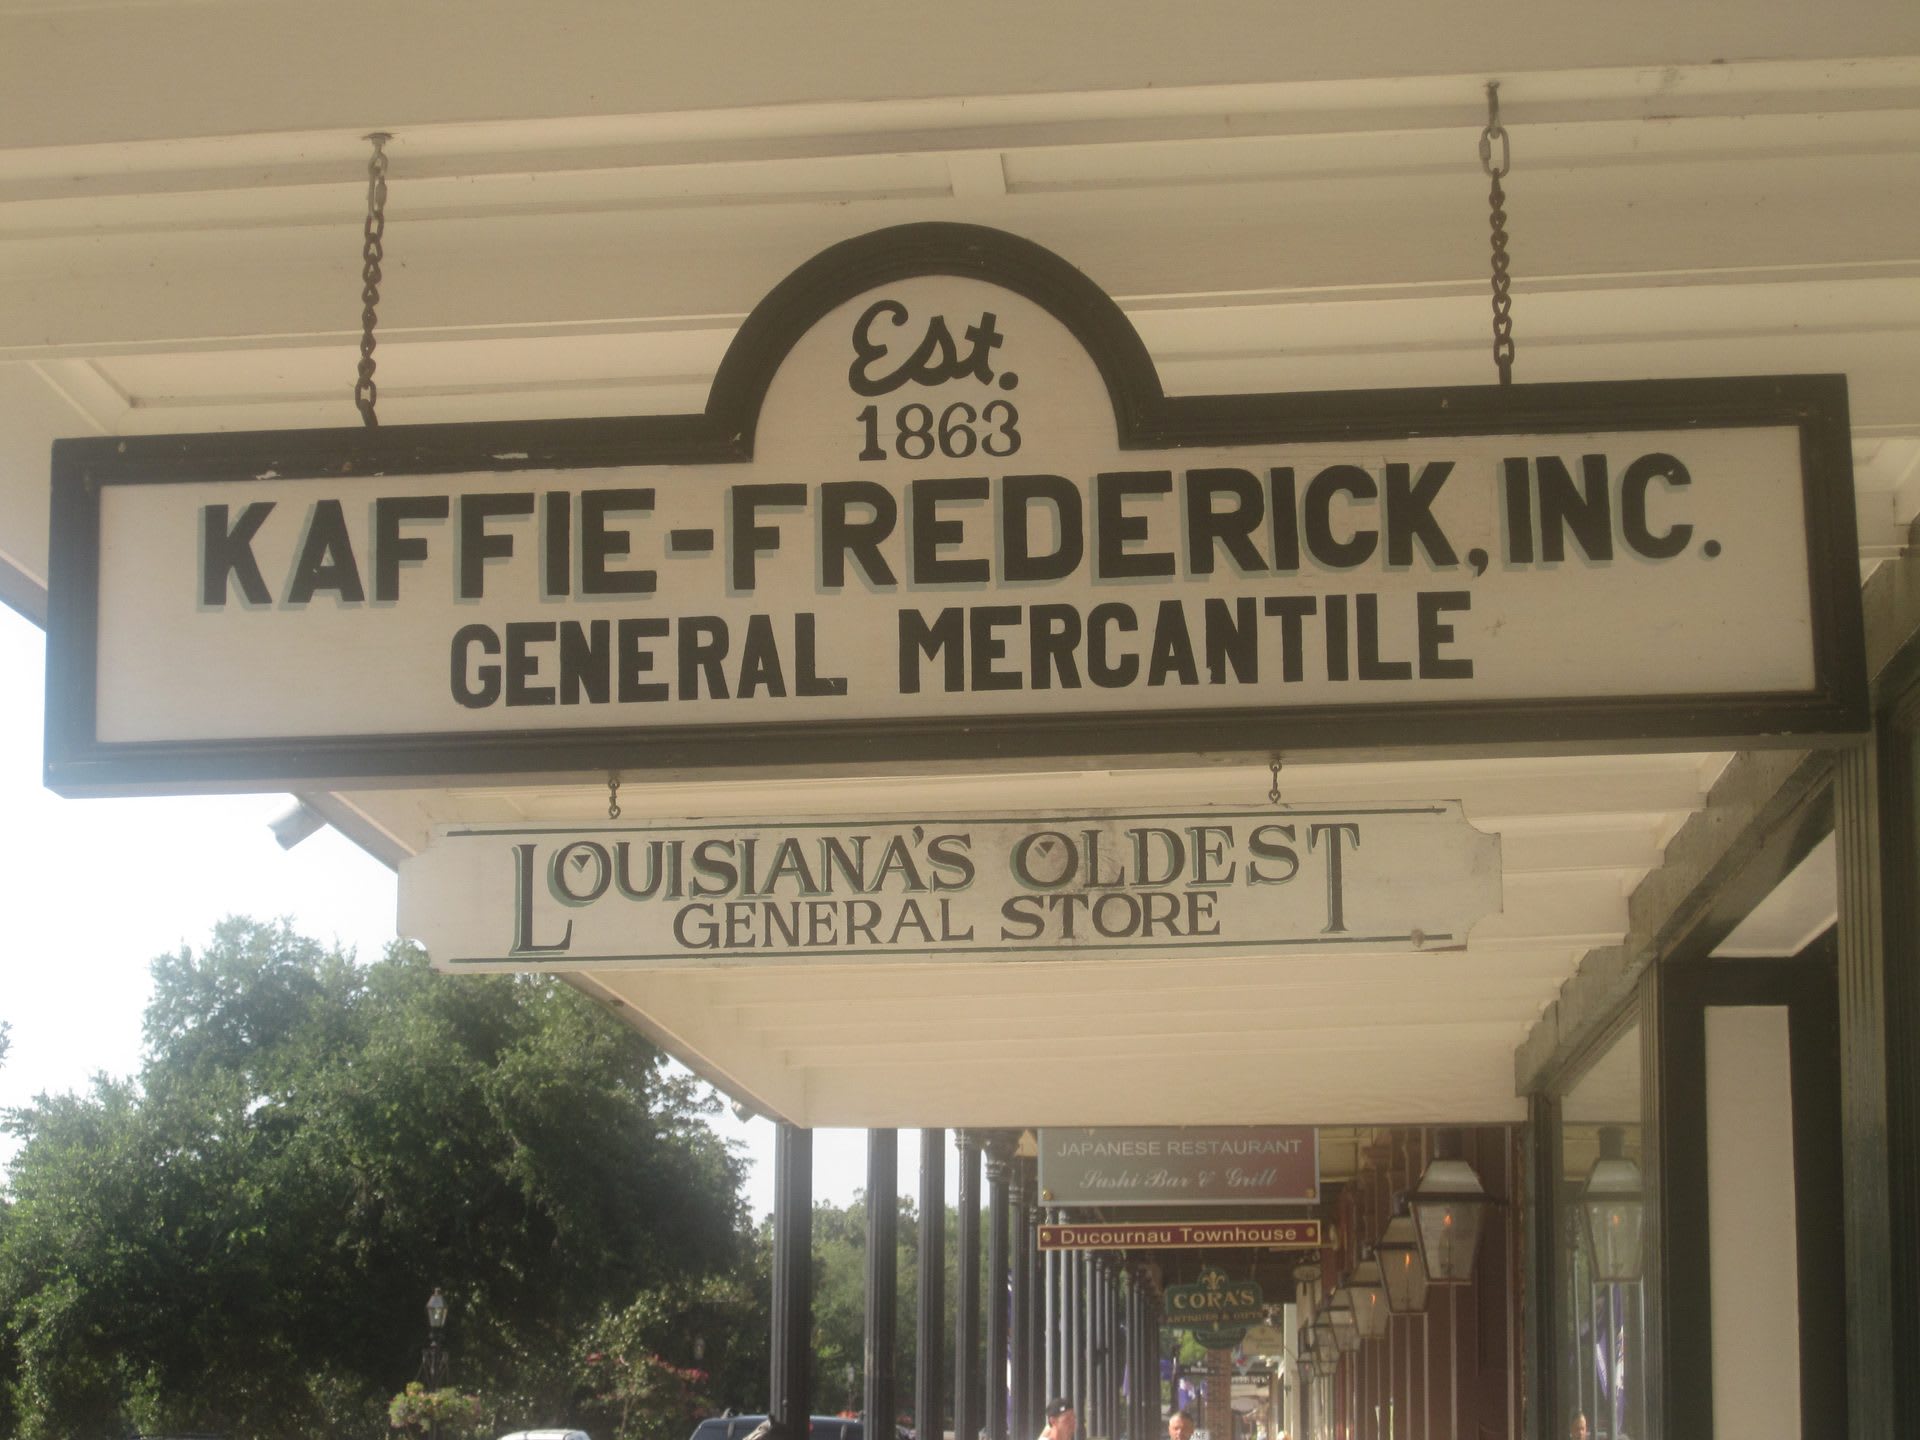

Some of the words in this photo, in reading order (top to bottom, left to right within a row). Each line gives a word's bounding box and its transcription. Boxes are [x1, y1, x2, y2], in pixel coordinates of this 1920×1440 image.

[848, 299, 1019, 397] Est.
[856, 400, 1021, 461] 1863
[199, 461, 1489, 607] KAFFIE-FREDERICK,
[1502, 453, 1722, 565] INC.
[450, 613, 848, 709] GENERAL
[899, 590, 1474, 694] MERCANTILE
[510, 825, 976, 957] LOUISIANA'S
[1010, 822, 1361, 934] OLDEST
[673, 898, 974, 950] GENERAL
[1001, 891, 1221, 941] STORE
[1057, 1141, 1161, 1157] JAPANESE
[1168, 1140, 1302, 1156] RESTAURANT
[1080, 1169, 1138, 1189] Sushi
[1143, 1168, 1188, 1188] Bar
[1225, 1167, 1277, 1188] Grill
[1060, 1230, 1171, 1245] Ducournau
[1179, 1226, 1297, 1243] Townhouse
[1173, 1289, 1255, 1310] CORA'S
